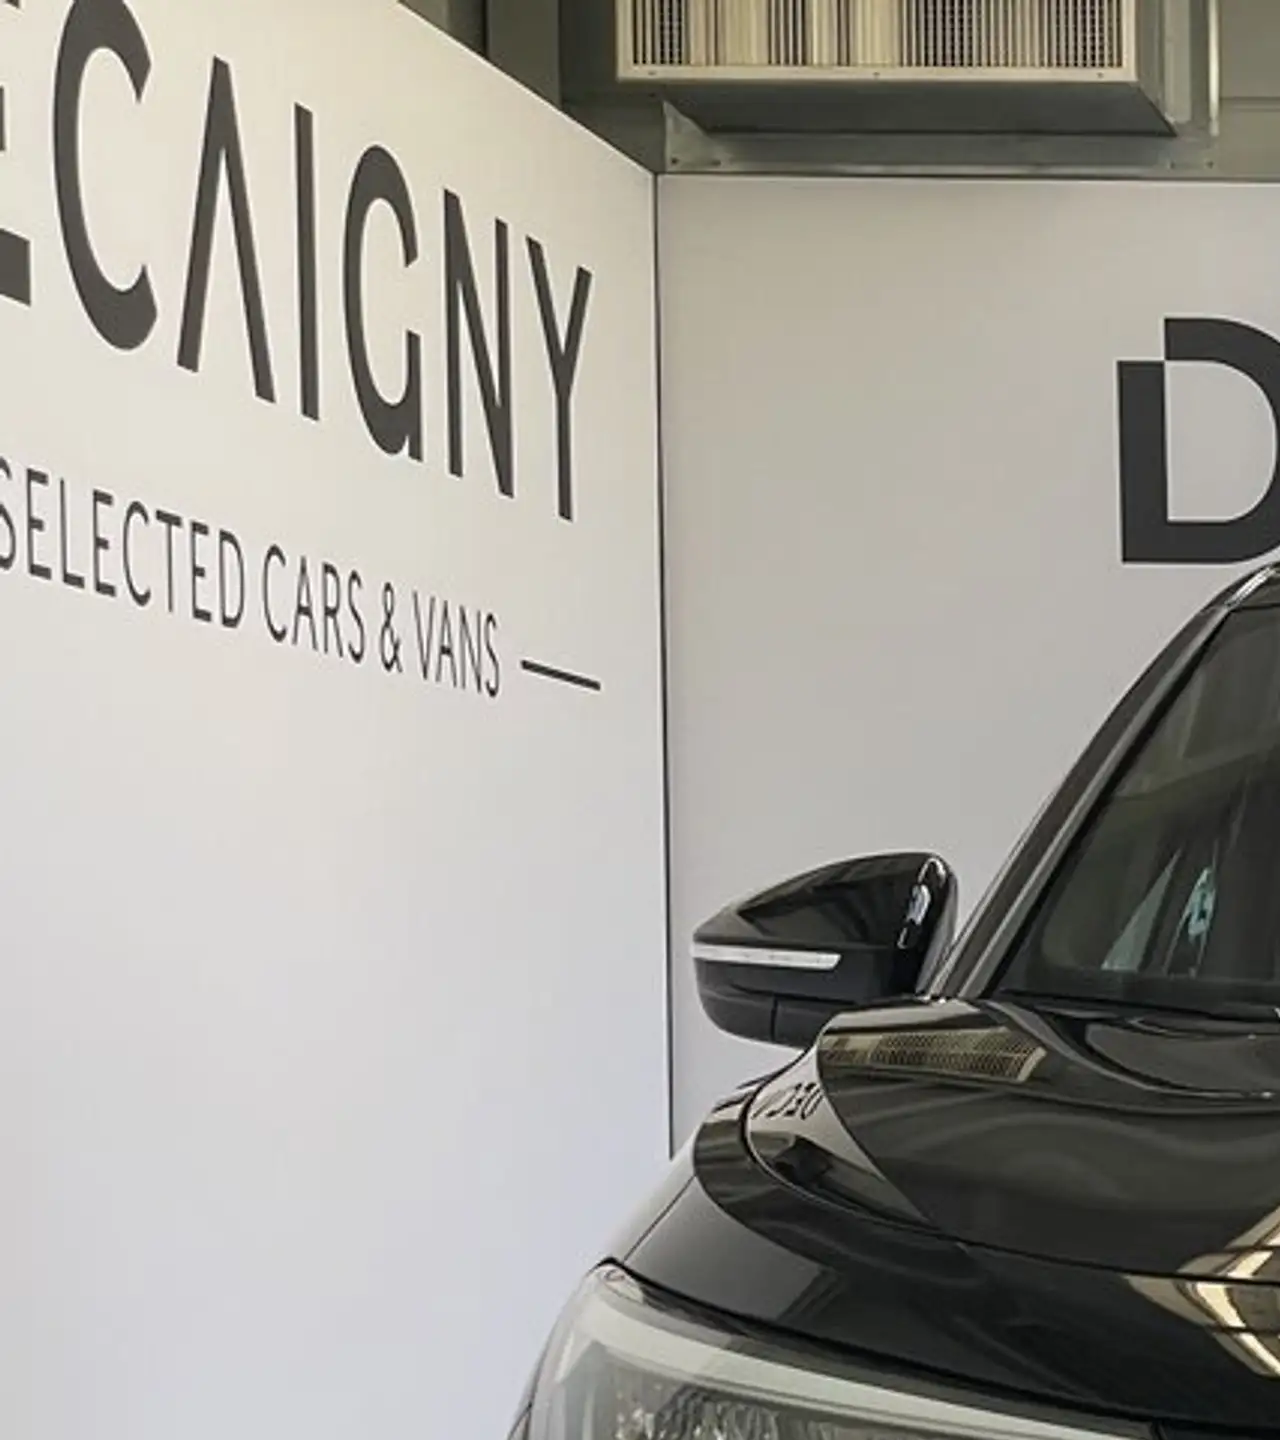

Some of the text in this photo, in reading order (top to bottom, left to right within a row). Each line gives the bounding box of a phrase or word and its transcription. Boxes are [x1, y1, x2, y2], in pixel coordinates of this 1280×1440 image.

[0, 0, 594, 522] CAIGNY
[0, 457, 500, 698] SELECTED CARS & VANS
